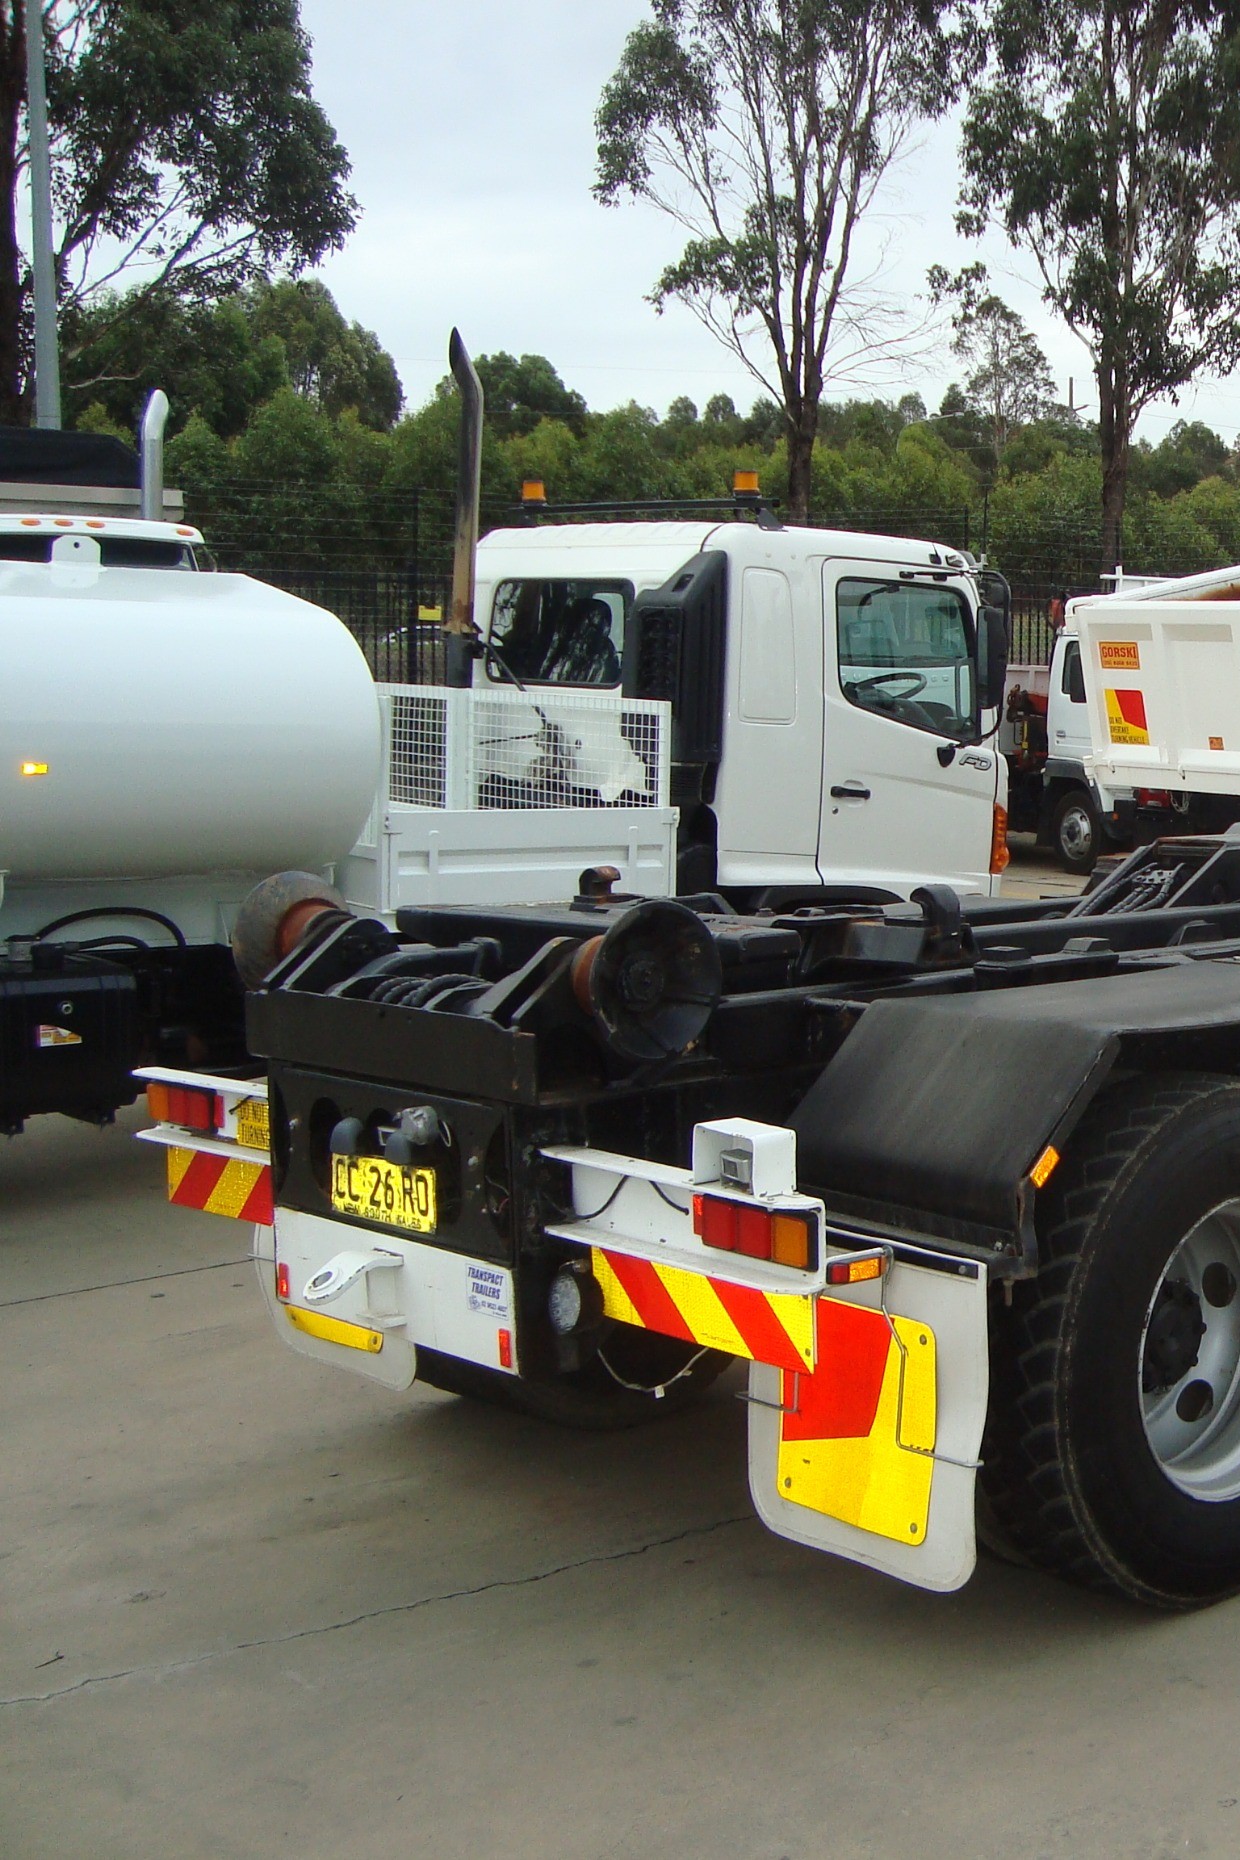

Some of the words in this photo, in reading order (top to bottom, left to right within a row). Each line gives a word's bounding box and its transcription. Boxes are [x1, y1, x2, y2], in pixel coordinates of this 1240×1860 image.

[1102, 646, 1137, 659] GORSKI
[959, 753, 992, 771] FD
[336, 1158, 360, 1202] CC
[369, 1165, 394, 1210] 26
[468, 1267, 503, 1286] TRANSPACT
[472, 1282, 500, 1299] TRAILERS
